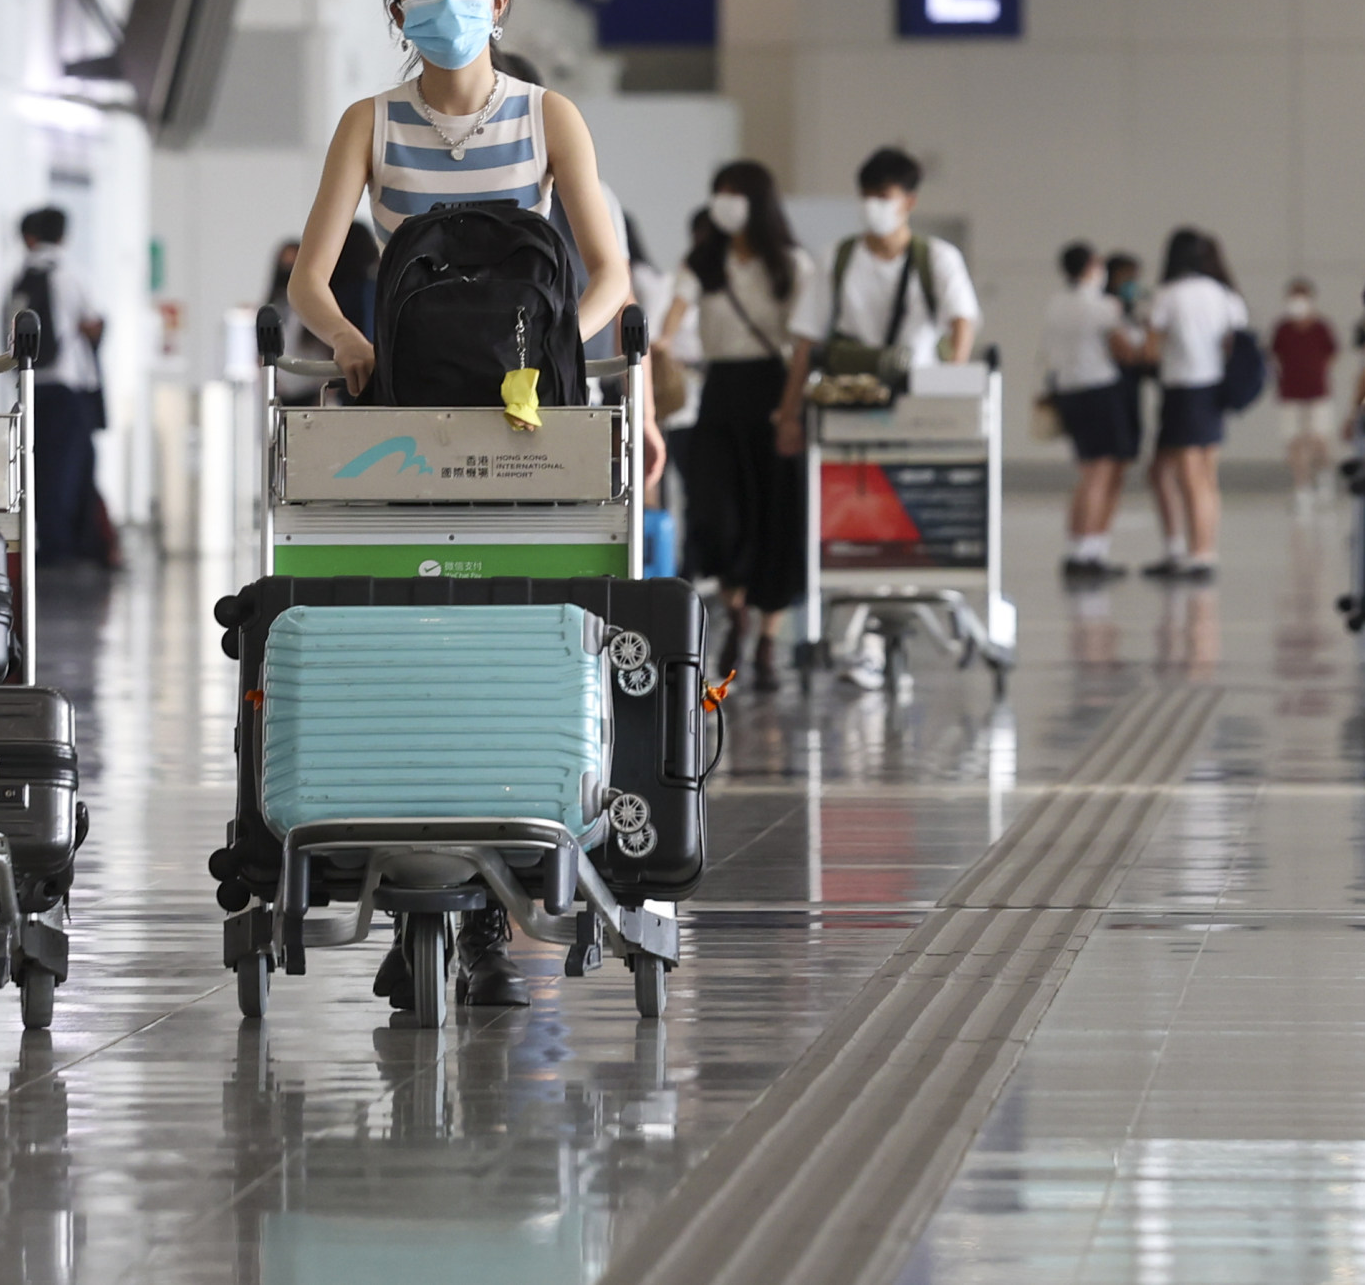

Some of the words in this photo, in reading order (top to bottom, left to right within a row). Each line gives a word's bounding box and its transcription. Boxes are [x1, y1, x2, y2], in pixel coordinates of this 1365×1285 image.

[466, 455, 488, 466] 香港
[496, 454, 521, 462] HONG
[523, 454, 548, 462] KONG
